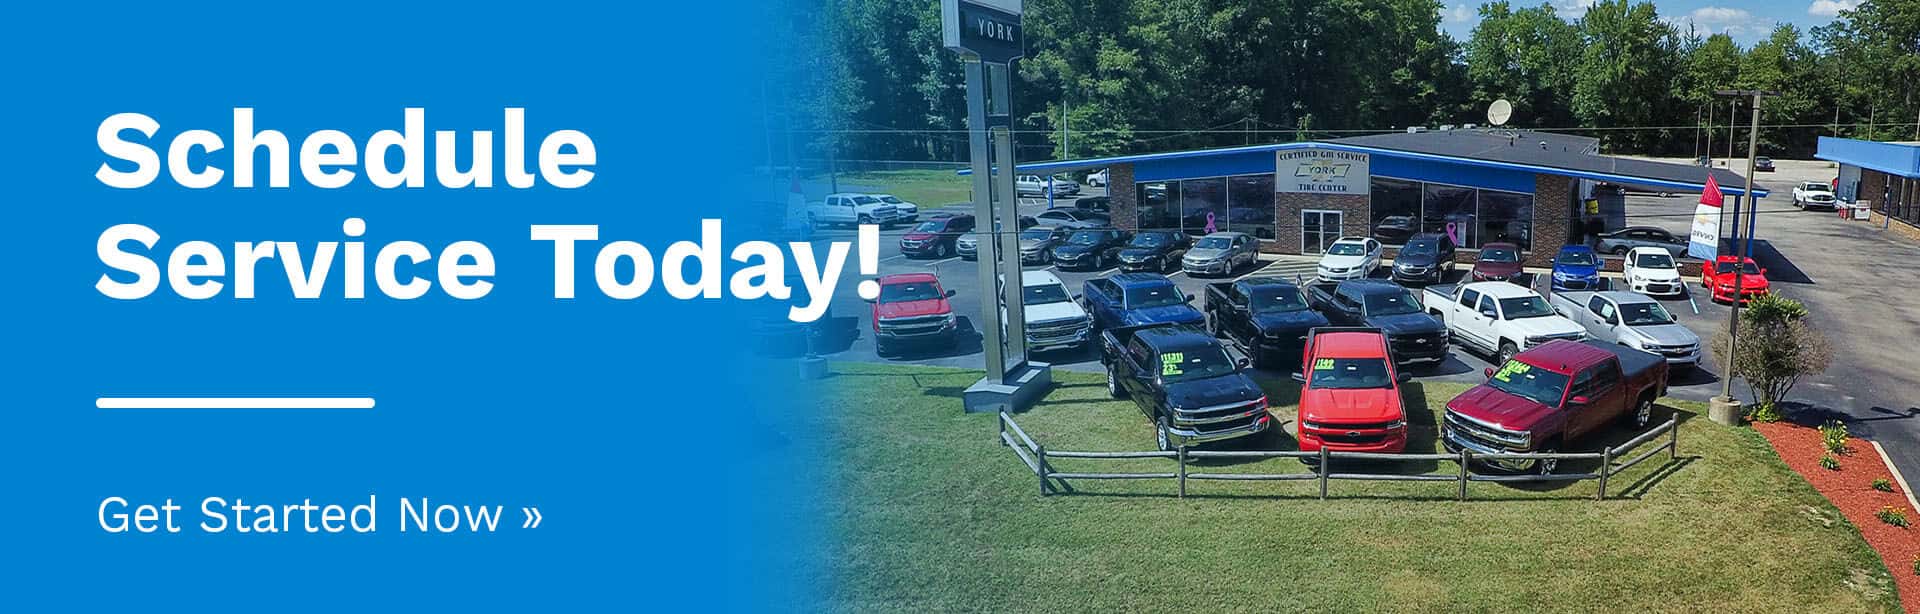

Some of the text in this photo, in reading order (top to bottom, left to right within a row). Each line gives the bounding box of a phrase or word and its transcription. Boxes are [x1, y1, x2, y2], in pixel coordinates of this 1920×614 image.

[977, 17, 1014, 42] YORK
[1336, 151, 1367, 162] SERVICE
[1309, 166, 1337, 175] YORK
[1318, 183, 1347, 192] CENTER
